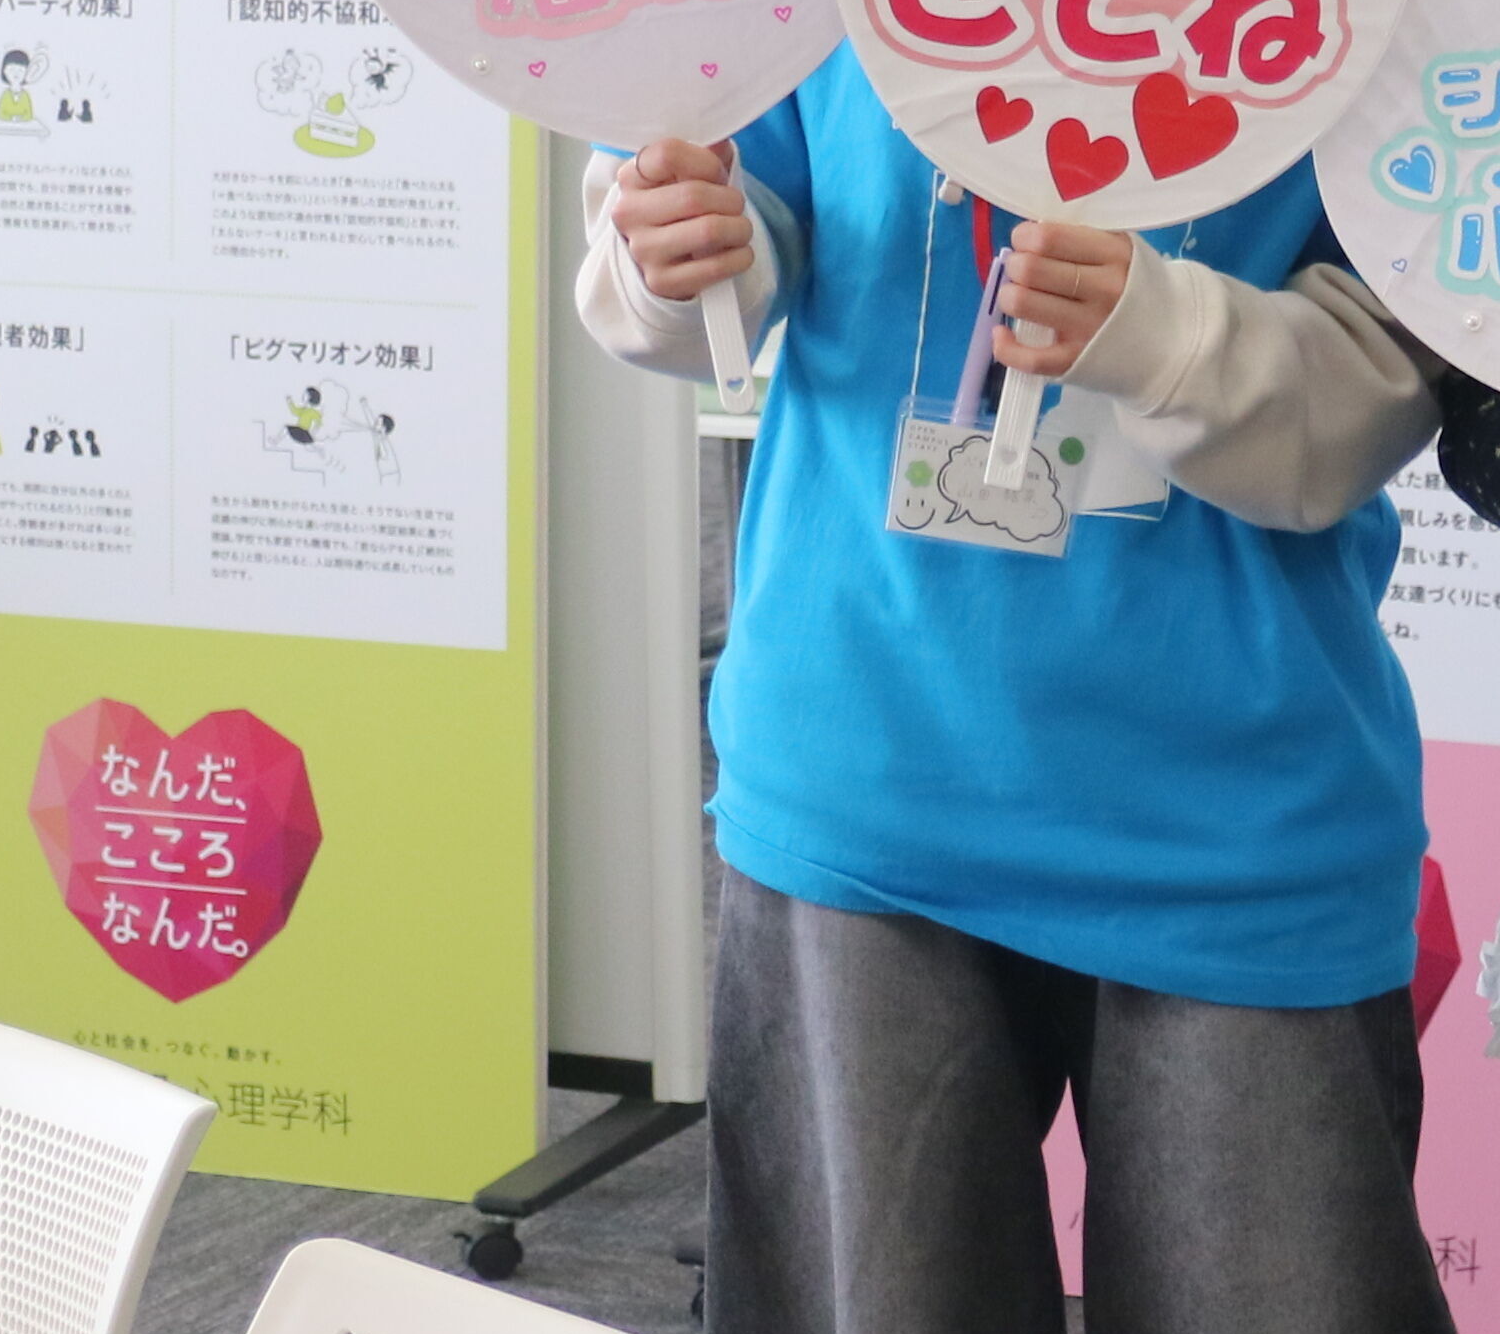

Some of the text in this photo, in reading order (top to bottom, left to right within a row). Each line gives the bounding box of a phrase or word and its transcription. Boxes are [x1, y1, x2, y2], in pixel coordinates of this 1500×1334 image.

[102, 821, 236, 879] こころ
[103, 892, 249, 959] なんだ。
